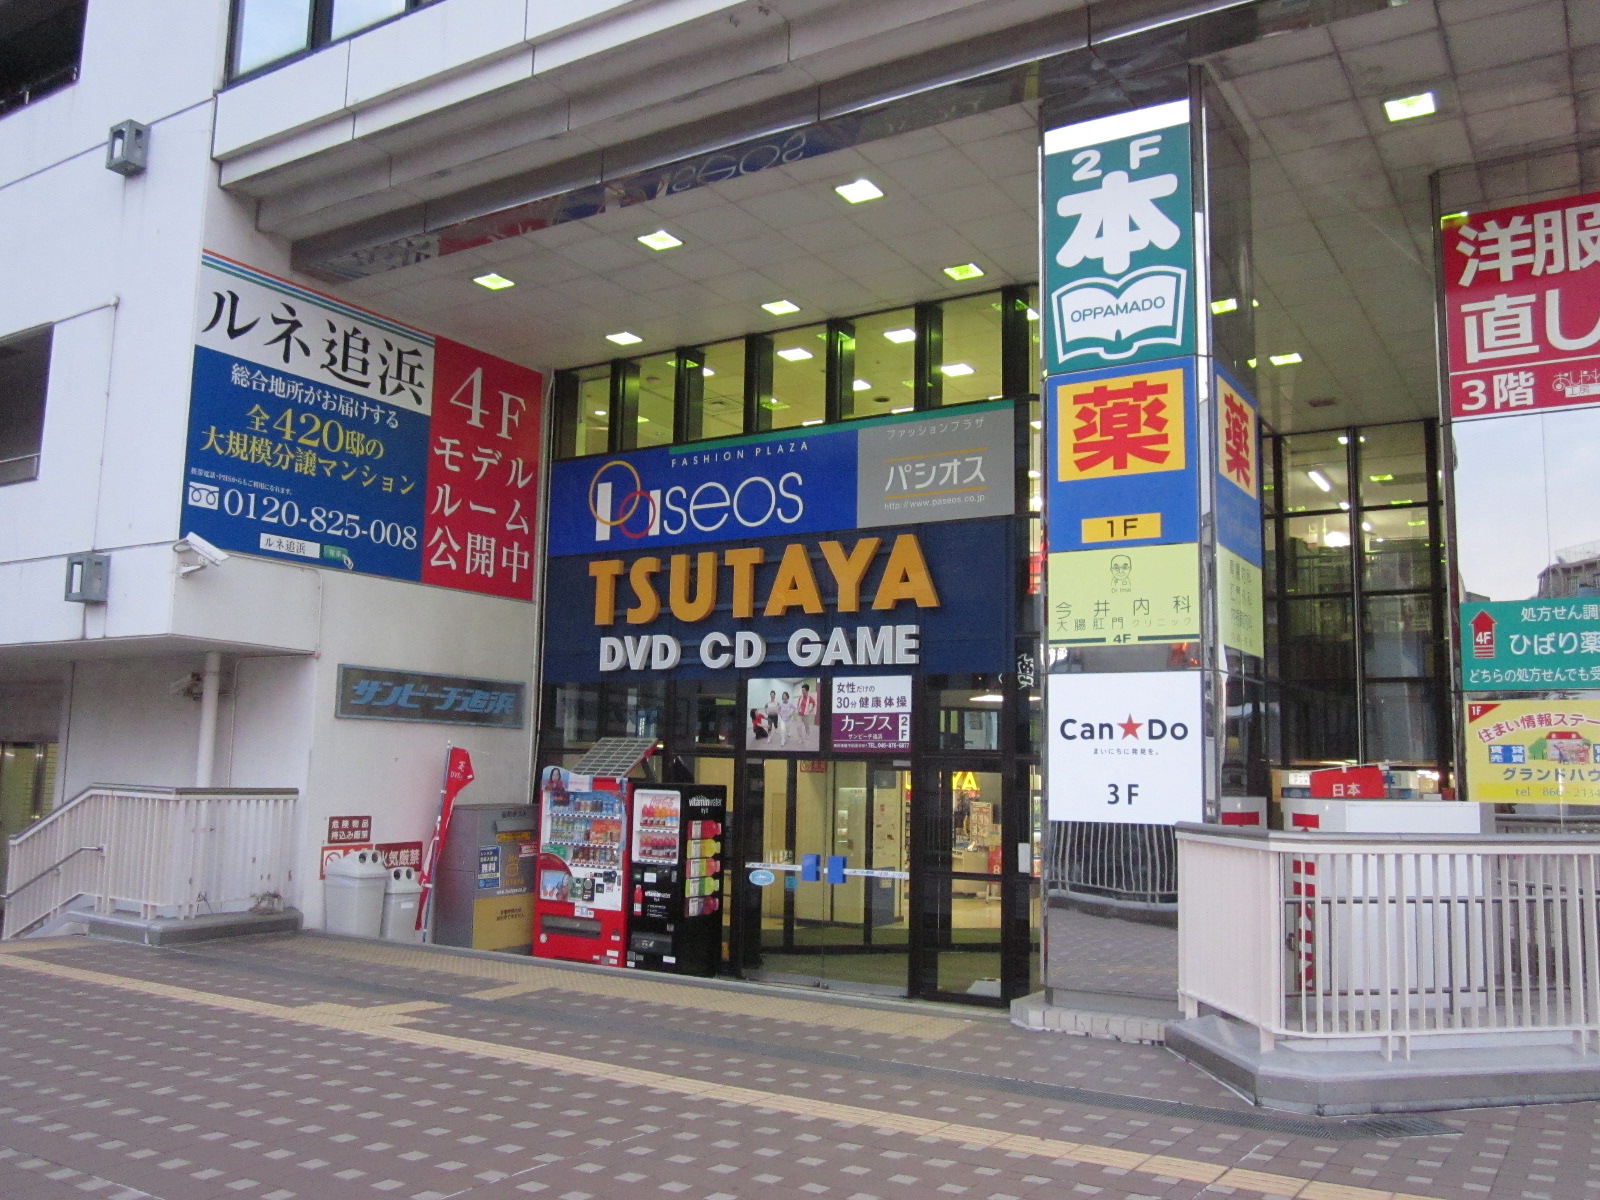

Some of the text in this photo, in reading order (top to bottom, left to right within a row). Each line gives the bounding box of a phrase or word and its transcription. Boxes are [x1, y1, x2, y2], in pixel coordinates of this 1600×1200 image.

[1056, 170, 1180, 274] 本
[1455, 202, 1600, 287] 洋服
[1070, 295, 1166, 323] OPPAMADO
[1460, 288, 1600, 364] 直し
[203, 289, 425, 405] ルネ追浜
[231, 363, 398, 429] 総合地所がお届けする
[450, 367, 526, 441] 4F
[1461, 371, 1535, 411] 3階
[246, 404, 384, 460] 全420邸の
[887, 417, 984, 440] ファッションプラザ
[1072, 381, 1171, 472] 薬
[1224, 393, 1252, 488] 薬
[200, 425, 416, 495] 大規模分譲マンション
[434, 436, 533, 488] モデル
[672, 441, 808, 467] FASHION PLAZA
[885, 456, 985, 492] パシオス
[431, 483, 529, 535] ルーム
[884, 494, 985, 510] http://www.paseos.co.jp
[224, 489, 417, 549] 0120-825-008
[1106, 518, 1138, 538] 1F
[265, 537, 305, 554] ルネ追浜
[427, 526, 529, 583] 公開中
[589, 533, 940, 626] TSUTAYA
[1056, 594, 1191, 620] 今井内科
[1521, 604, 1600, 623] 処方せん調
[1056, 617, 1192, 632] 大腸肛門クリニック
[1113, 633, 1131, 644] 4F
[1475, 631, 1492, 645] 4F
[600, 624, 920, 671] DVD CD GAME
[1509, 631, 1600, 655] ひばり薬
[836, 682, 876, 694] 女性だけの
[1469, 666, 1600, 684] どちらの処方せんでも受
[841, 715, 893, 731] カーブス
[1471, 705, 1482, 716] 1F
[1093, 748, 1159, 756] まいにちに発見を。
[1107, 783, 1139, 805] 3F
[1332, 782, 1361, 797] 日本
